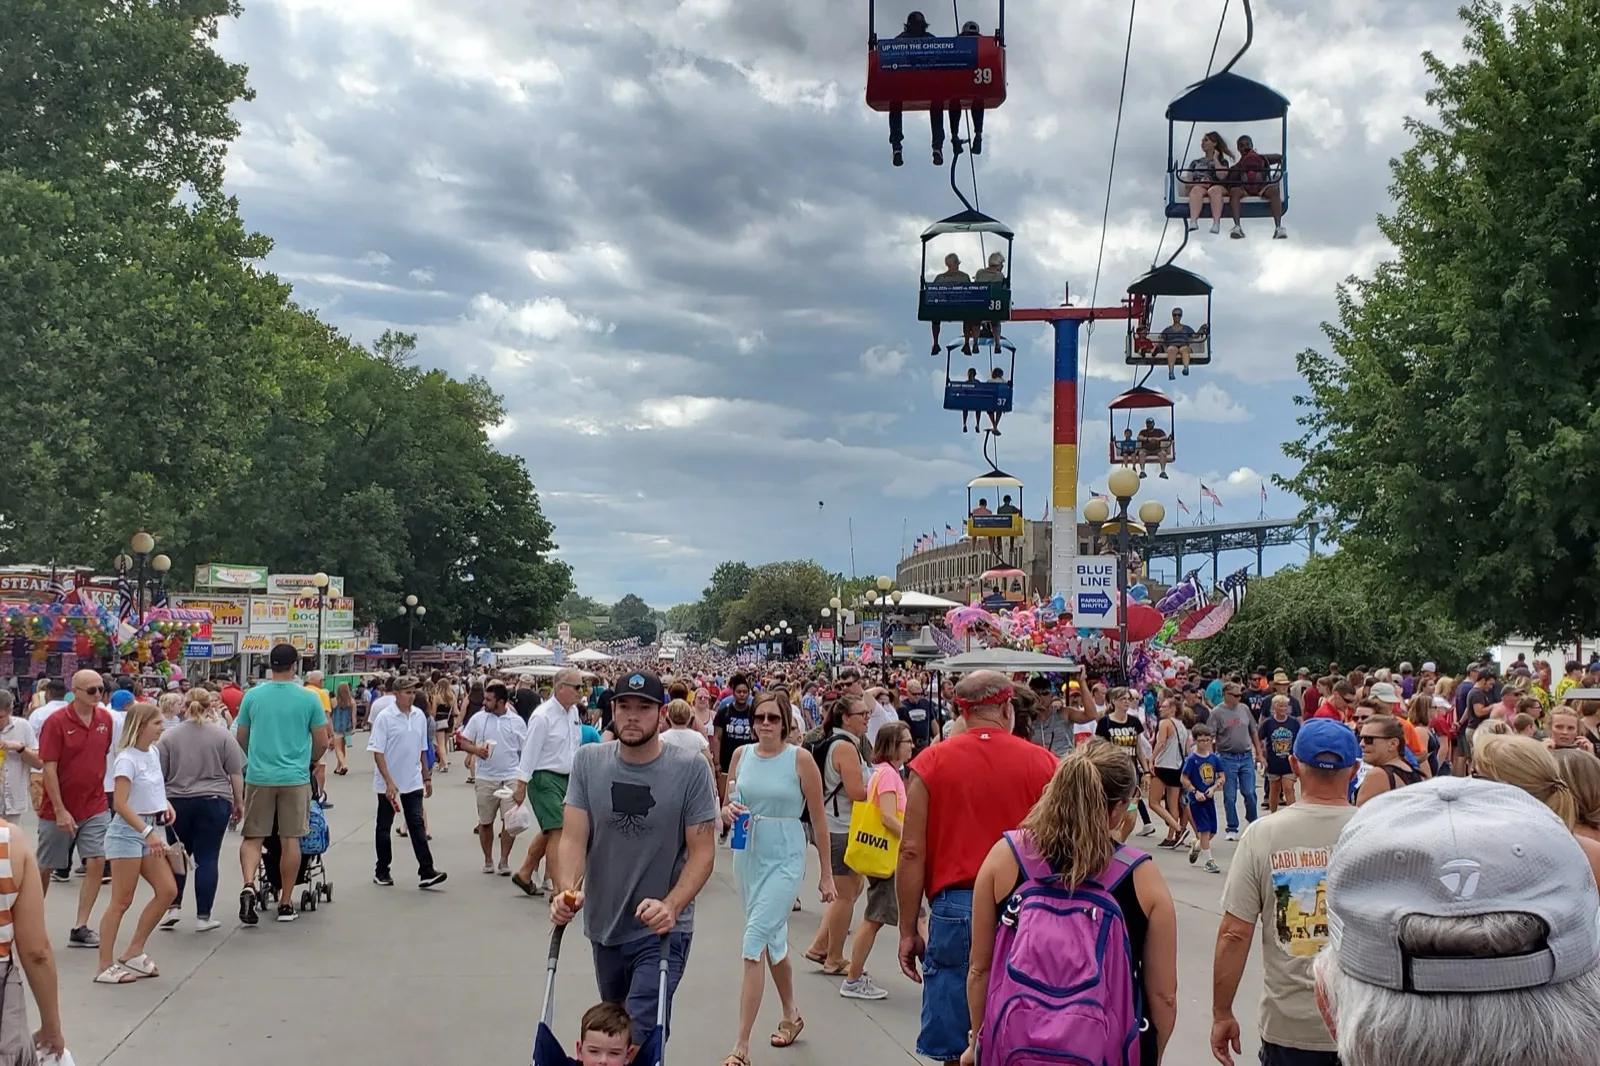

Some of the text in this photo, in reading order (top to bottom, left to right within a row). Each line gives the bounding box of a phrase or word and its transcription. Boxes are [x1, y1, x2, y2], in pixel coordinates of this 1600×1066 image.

[973, 68, 992, 84] 39
[988, 300, 1001, 310] 38
[997, 398, 1007, 406] 37
[1076, 564, 1113, 575] BLUE
[1080, 576, 1111, 587] LINE
[221, 615, 243, 625] TIPS
[1108, 727, 1137, 736] 100%
[855, 830, 889, 851] IOWA
[1299, 850, 1328, 868] WABO
